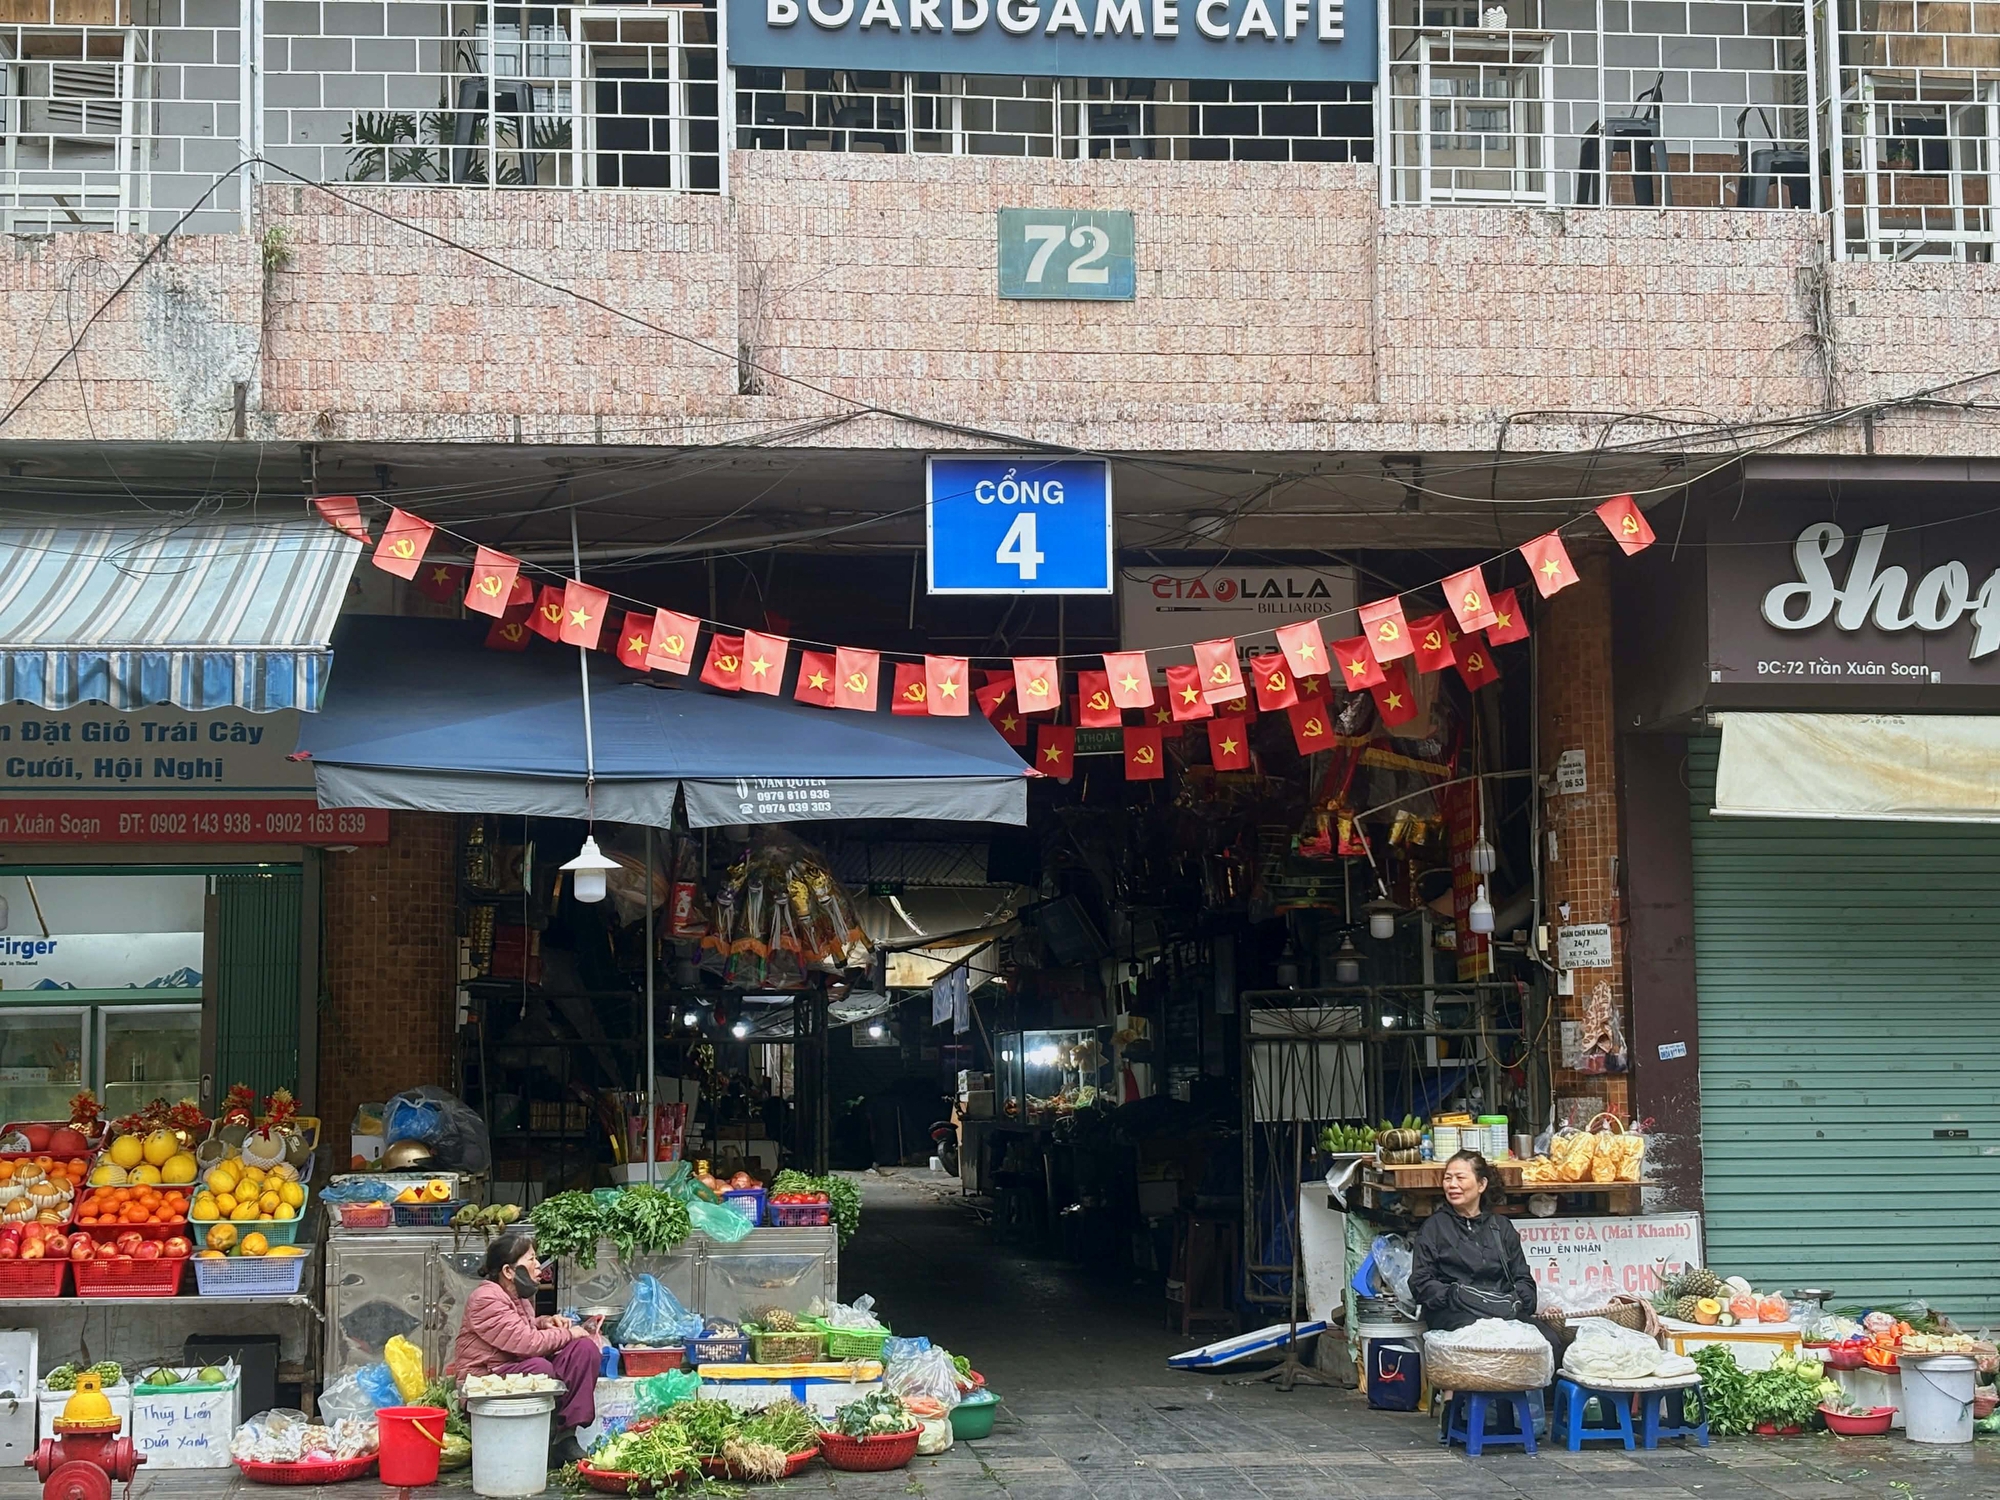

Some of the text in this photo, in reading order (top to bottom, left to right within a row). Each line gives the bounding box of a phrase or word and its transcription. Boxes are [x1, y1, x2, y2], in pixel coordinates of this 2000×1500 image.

[767, 0, 1345, 40] BOARDGAME CAFE
[1024, 225, 1109, 284] 72
[974, 467, 1064, 505] CỔNG
[995, 512, 1045, 580] 4
[1257, 602, 1333, 614] BILLIARDS
[1757, 656, 1930, 679] ĐC:72 Trần Xuân Soạn
[21, 720, 71, 746] Đặt
[81, 719, 131, 743] Giỏ
[141, 720, 198, 742] Trái
[209, 721, 264, 745] Cây
[6, 756, 223, 783] Cưới, Hội Nghị
[757, 790, 830, 801] 0979 810 936
[759, 802, 831, 813] 0974 039 303
[14, 813, 54, 834] Xuân
[60, 813, 100, 839] Soạn
[119, 813, 144, 834] ĐT:
[150, 813, 187, 834] 0902
[192, 813, 219, 834] 143
[223, 813, 251, 834] 938
[266, 813, 302, 834] 0902
[307, 813, 334, 833] 163
[338, 813, 366, 833] 839
[1574, 939, 1590, 948] 24/7
[1574, 1221, 1598, 1241] GÀ
[1602, 1224, 1633, 1242] (Mai
[1637, 1222, 1691, 1240] Khanh)
